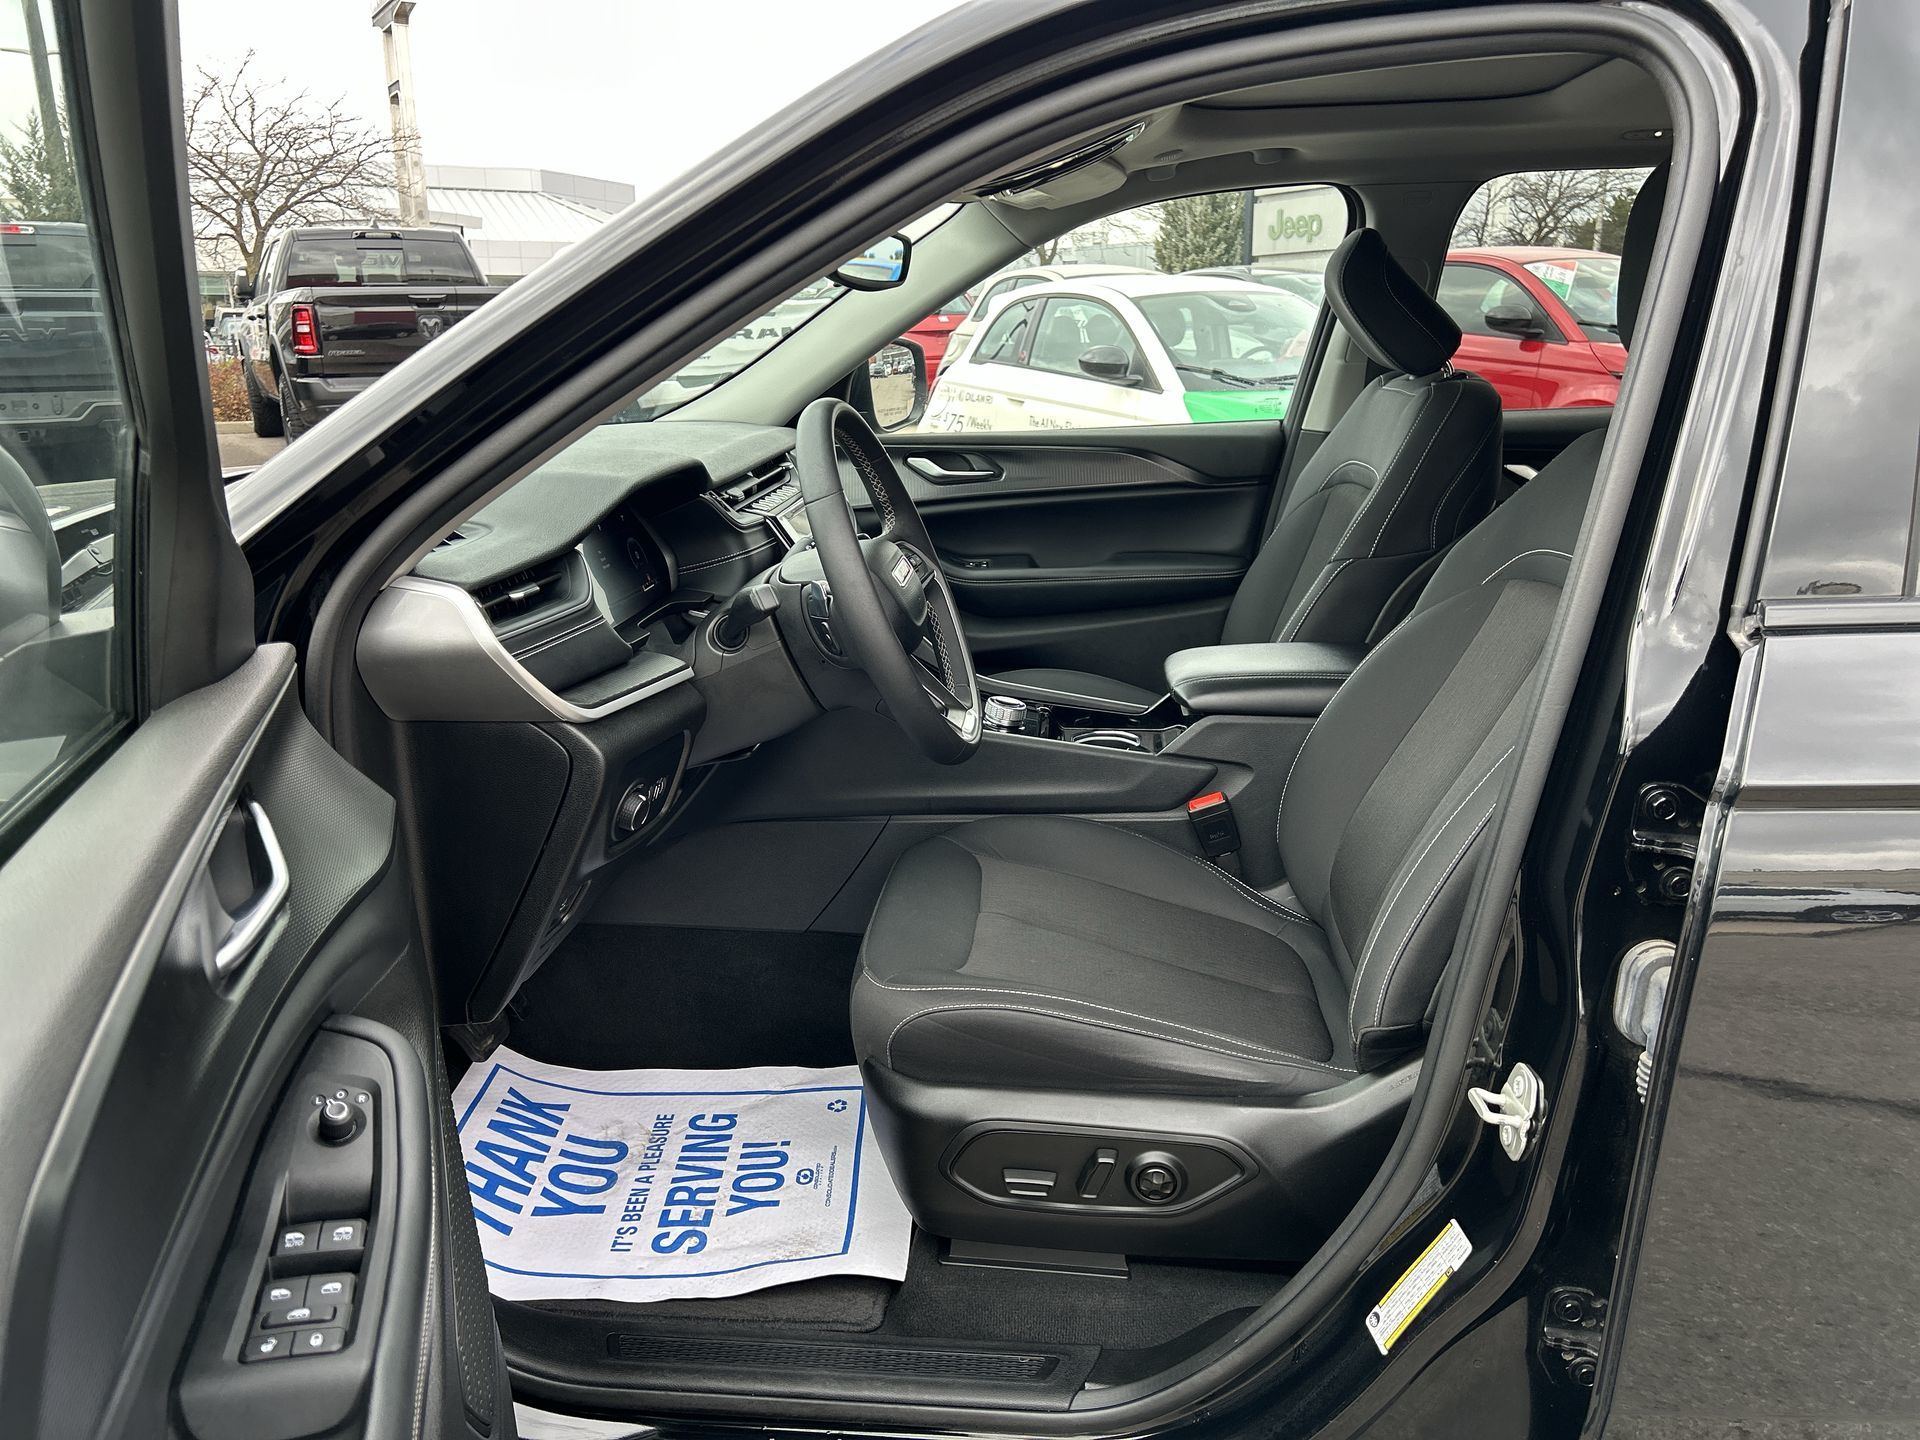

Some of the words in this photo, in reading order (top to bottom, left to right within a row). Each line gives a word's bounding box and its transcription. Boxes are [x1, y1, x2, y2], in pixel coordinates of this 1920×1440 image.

[1268, 208, 1322, 243] Jeep
[315, 1097, 322, 1105] L
[358, 1095, 366, 1103] R
[638, 1114, 675, 1171] PLEASURE
[531, 1134, 629, 1217] YOU
[634, 1175, 655, 1184] A
[651, 1113, 738, 1254] SERVING
[726, 1140, 791, 1217] YOU!
[620, 1188, 651, 1222] BEEN
[610, 1226, 638, 1252] IT'S
